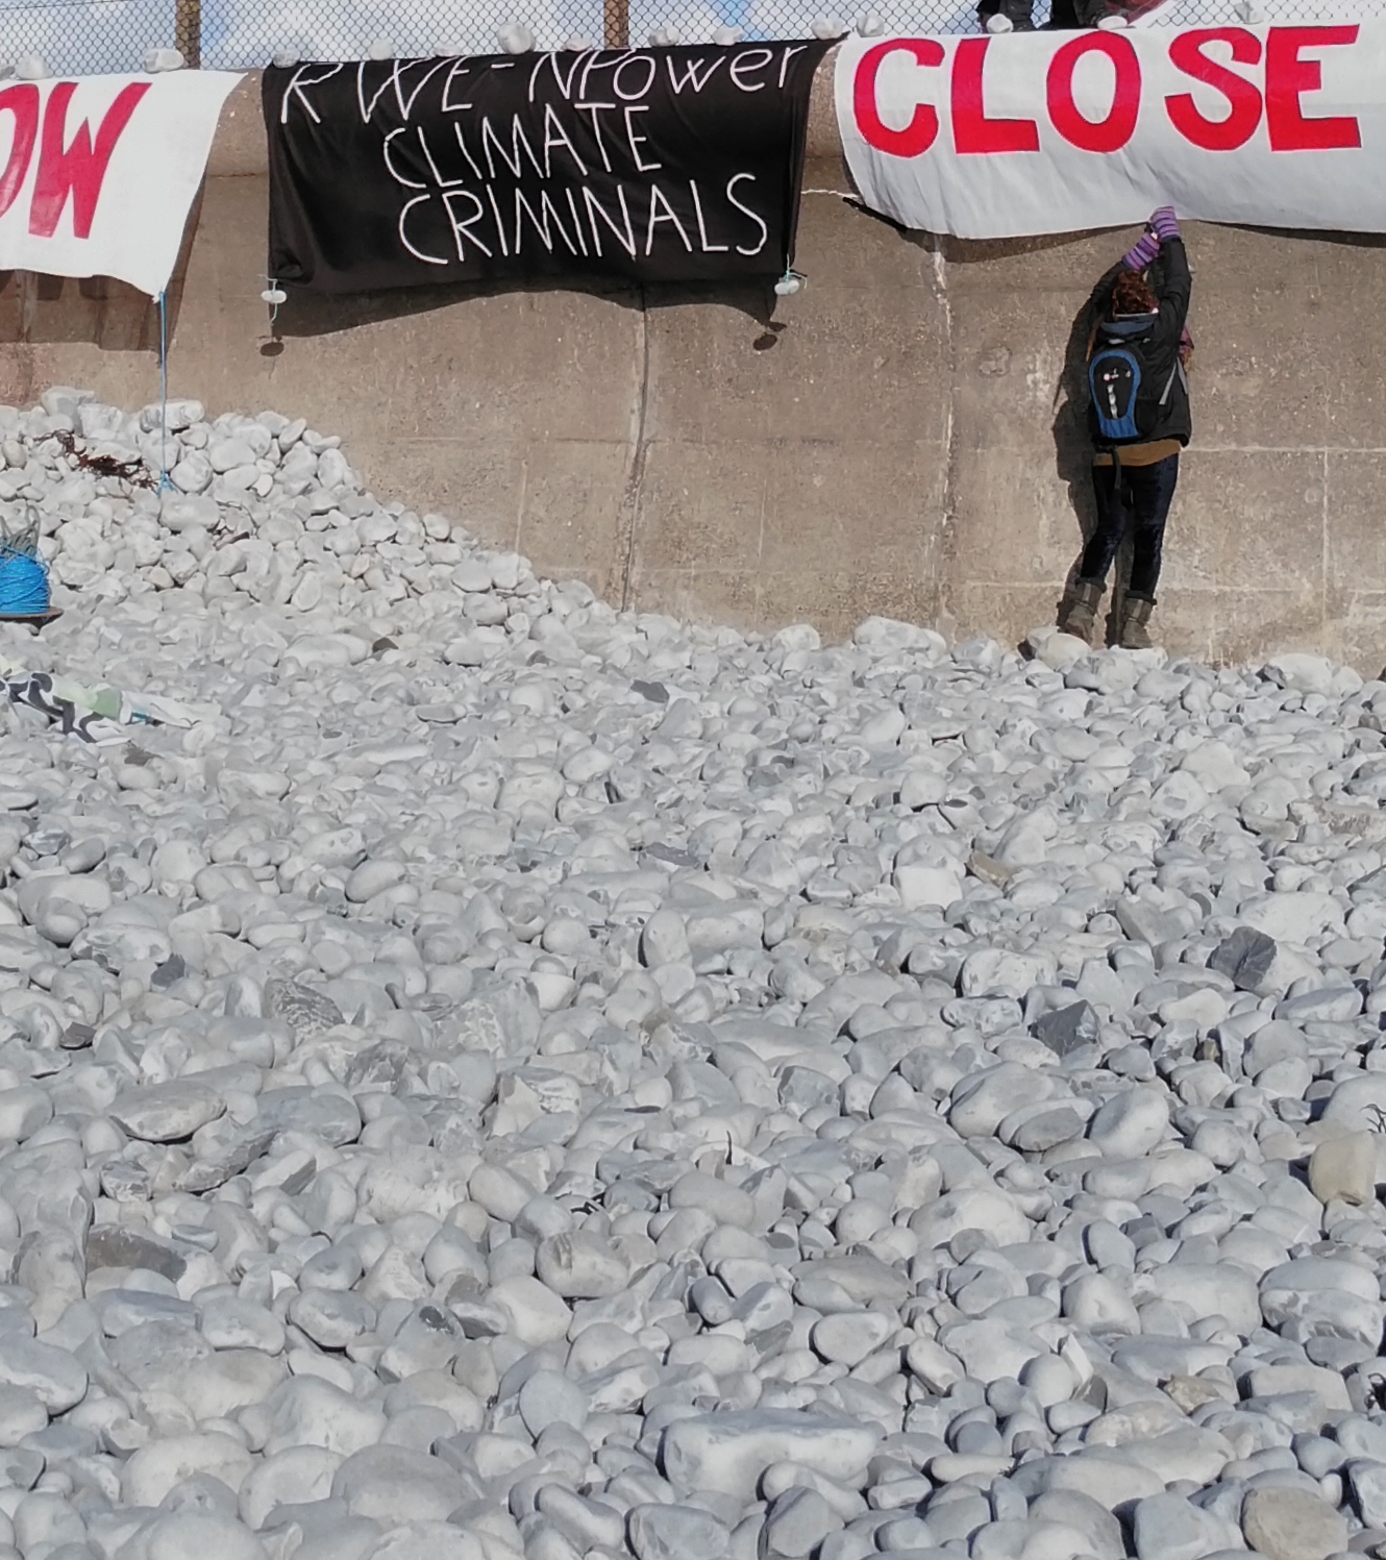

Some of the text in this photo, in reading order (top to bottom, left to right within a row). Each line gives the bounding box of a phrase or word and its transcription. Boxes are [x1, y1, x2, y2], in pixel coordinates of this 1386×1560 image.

[852, 23, 1362, 159] CLOSE
[382, 102, 663, 189] CLIMATE
[398, 172, 769, 266] CRIMINALS
